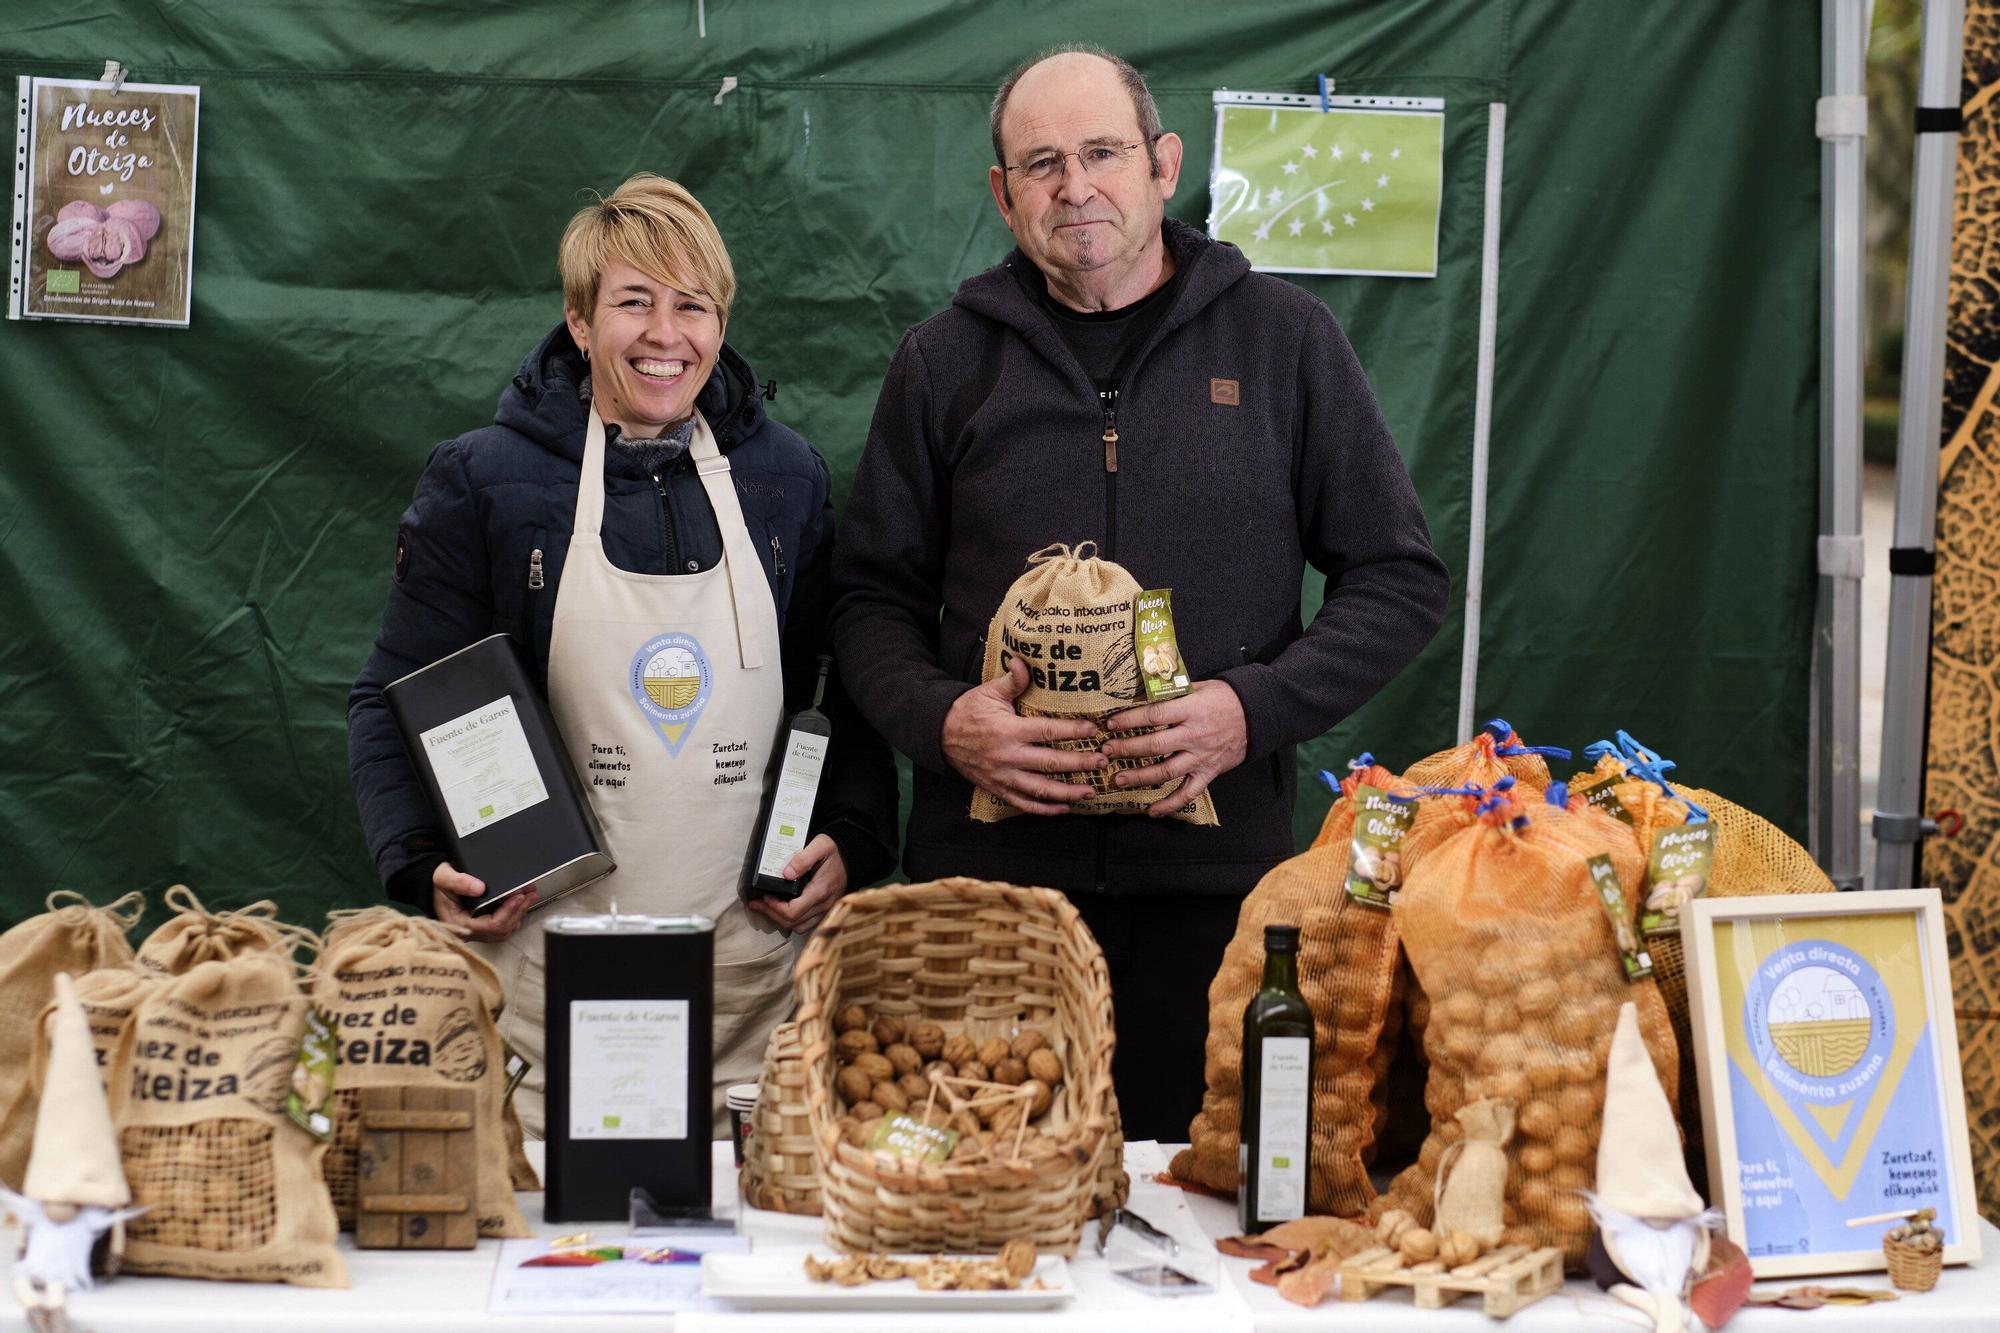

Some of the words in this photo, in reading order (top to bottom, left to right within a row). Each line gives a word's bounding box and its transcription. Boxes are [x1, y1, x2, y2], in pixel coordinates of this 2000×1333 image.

[61, 103, 156, 131] Nueces
[105, 129, 128, 147] de
[67, 145, 154, 182] Oteiza
[1138, 597, 1165, 613] Nueces
[1151, 610, 1158, 618] de
[1056, 623, 1072, 633] de
[1075, 621, 1125, 634] Navarra
[1141, 619, 1168, 635] Oteiza
[646, 637, 672, 653] Venta
[673, 636, 699, 653] directa
[1002, 624, 1043, 659] Nuez
[1050, 640, 1082, 660] de
[1000, 649, 1100, 692] Oeiza
[639, 697, 678, 720] Salmenta
[680, 697, 705, 720] zuzena
[428, 727, 463, 747] Fuente
[465, 720, 478, 732] de
[480, 707, 510, 724] Garos
[592, 743, 613, 755] Para
[615, 744, 626, 756] ti,
[712, 740, 748, 754] Zuretzat,
[796, 742, 818, 753] Fuente
[715, 759, 746, 769] hemengo
[801, 752, 821, 761] Garos
[588, 760, 631, 771] alimentos
[593, 777, 604, 786] de
[606, 776, 626, 789] aquí
[714, 772, 747, 785] elikagaiak
[1366, 796, 1410, 818] Nueces
[1367, 819, 1405, 842] Oteiza
[1660, 829, 1709, 849] Nueces
[1764, 950, 1807, 979] Venta
[1808, 947, 1861, 976] directa
[383, 1003, 417, 1027] de
[579, 1011, 621, 1022] Fuente
[624, 1010, 638, 1021] de
[643, 1010, 681, 1021] Garos
[185, 1045, 221, 1066] de
[1272, 1053, 1299, 1061] Fuente
[1766, 1057, 1836, 1098] Salmenta
[1838, 1054, 1883, 1095] zuzena
[1882, 1151, 1936, 1165] Zuretzat,
[1889, 1168, 1938, 1181] hemengo
[1883, 1181, 1940, 1199] elikagaiak
[1756, 1192, 1783, 1209] aquí
